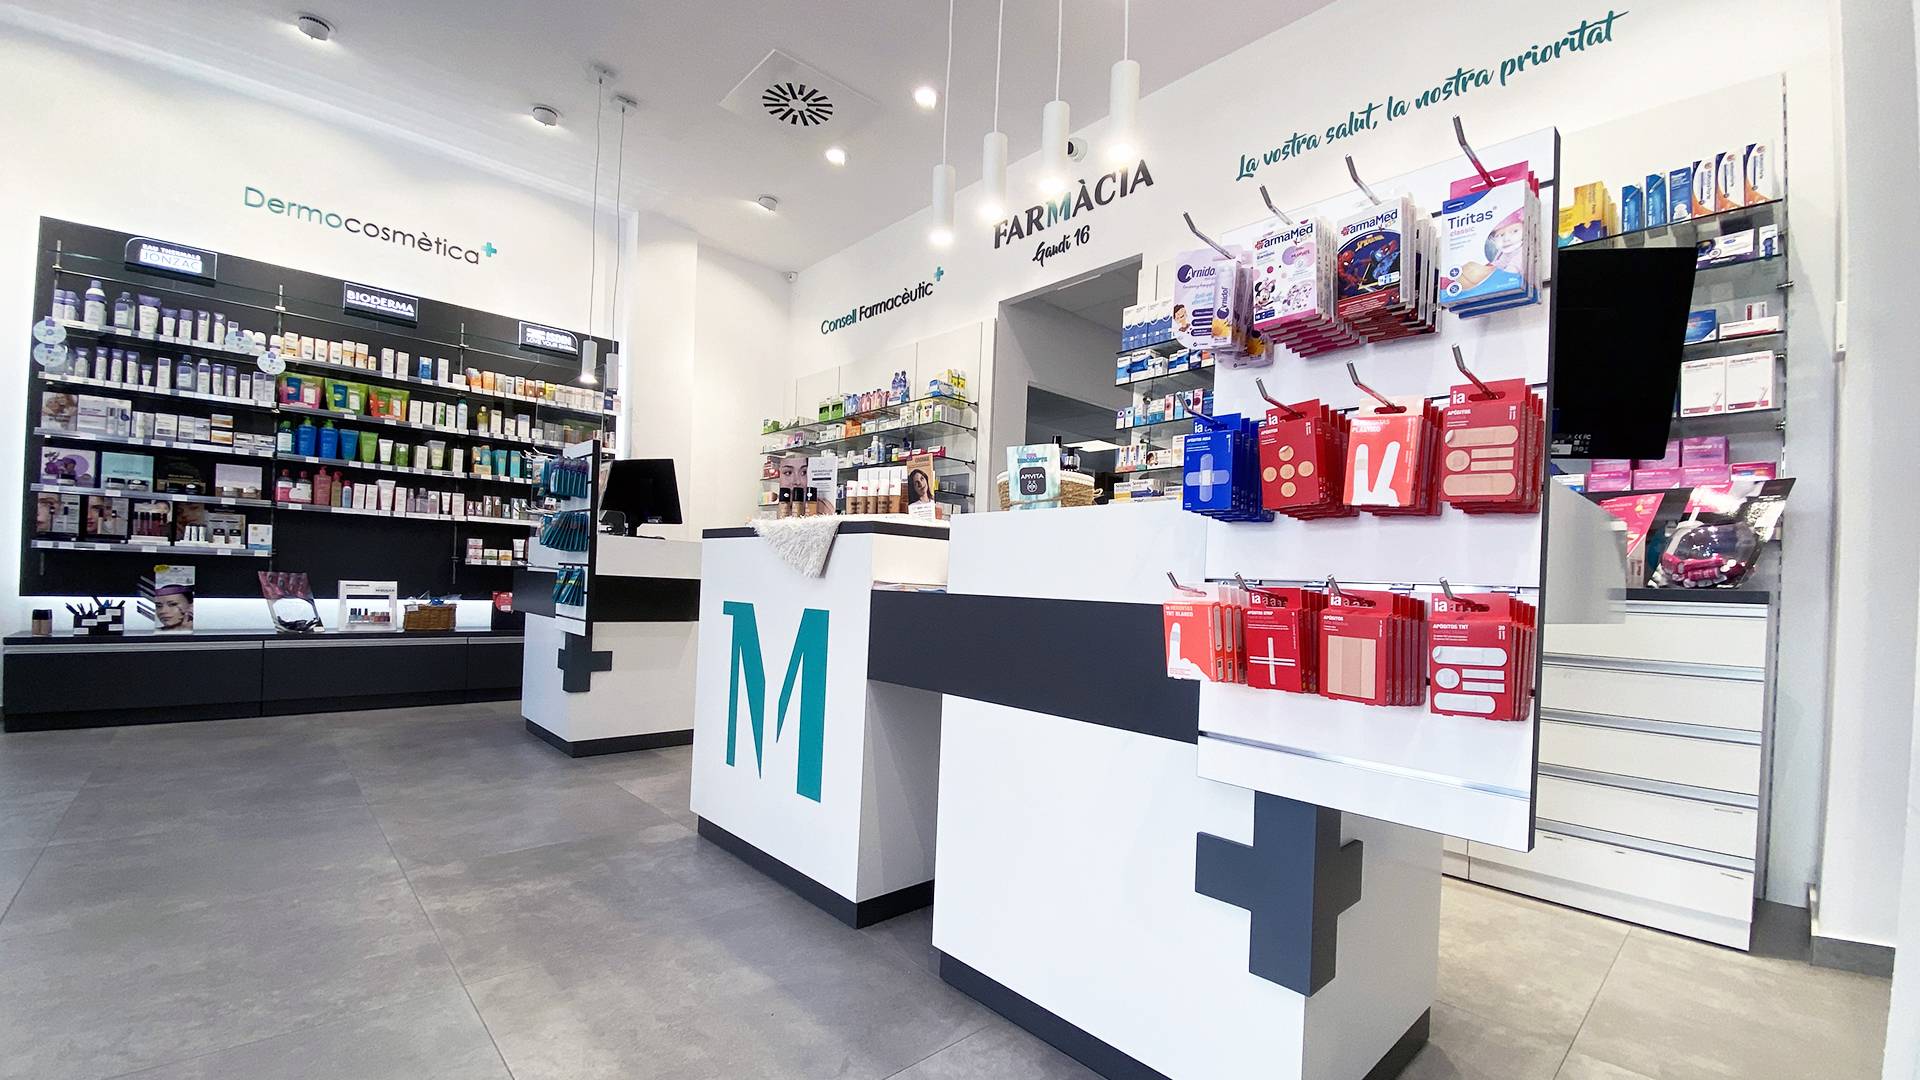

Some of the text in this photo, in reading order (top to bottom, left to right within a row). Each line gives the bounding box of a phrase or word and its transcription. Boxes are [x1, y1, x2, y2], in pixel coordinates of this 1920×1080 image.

[1236, 10, 1630, 182] La vostra salut, la nostra prioritat
[992, 158, 1154, 250] FARMÀCIA
[243, 185, 480, 265] Dermocosmètica
[1447, 209, 1493, 230] Tiritas
[1074, 224, 1090, 246] 16
[143, 251, 200, 271] JONZAC
[1185, 265, 1217, 281] Arnido
[346, 290, 415, 313] BIODERMA
[820, 281, 934, 335] Consell Farmacèutic
[1452, 391, 1466, 405] ia
[1194, 421, 1204, 434] ia
[1268, 413, 1279, 426] ia
[1330, 593, 1342, 606] ia
[1434, 598, 1448, 612] ia
[723, 600, 830, 803] M
